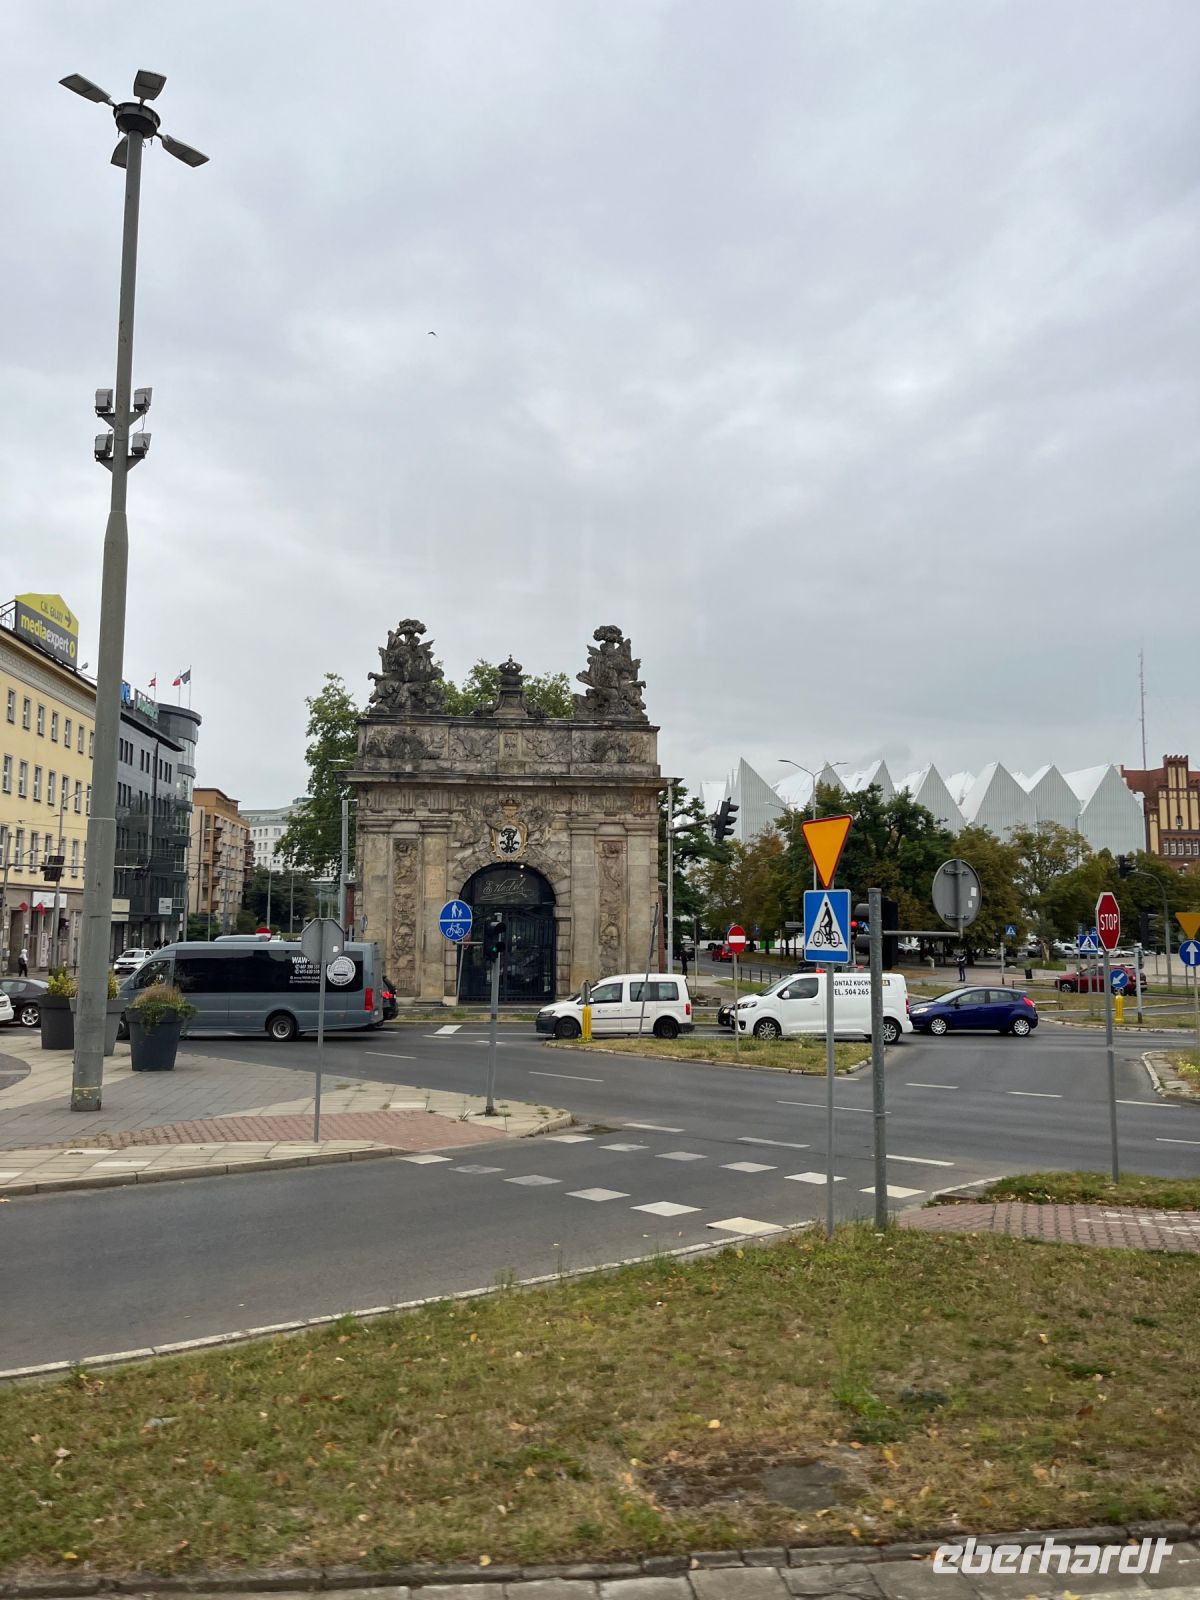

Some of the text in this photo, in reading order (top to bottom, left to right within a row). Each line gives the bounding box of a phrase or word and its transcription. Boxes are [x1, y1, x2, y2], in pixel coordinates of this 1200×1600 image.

[20, 614, 70, 654] mediaexpert
[1100, 913, 1118, 931] STOP
[844, 988, 857, 996] 504
[857, 988, 870, 996] 265
